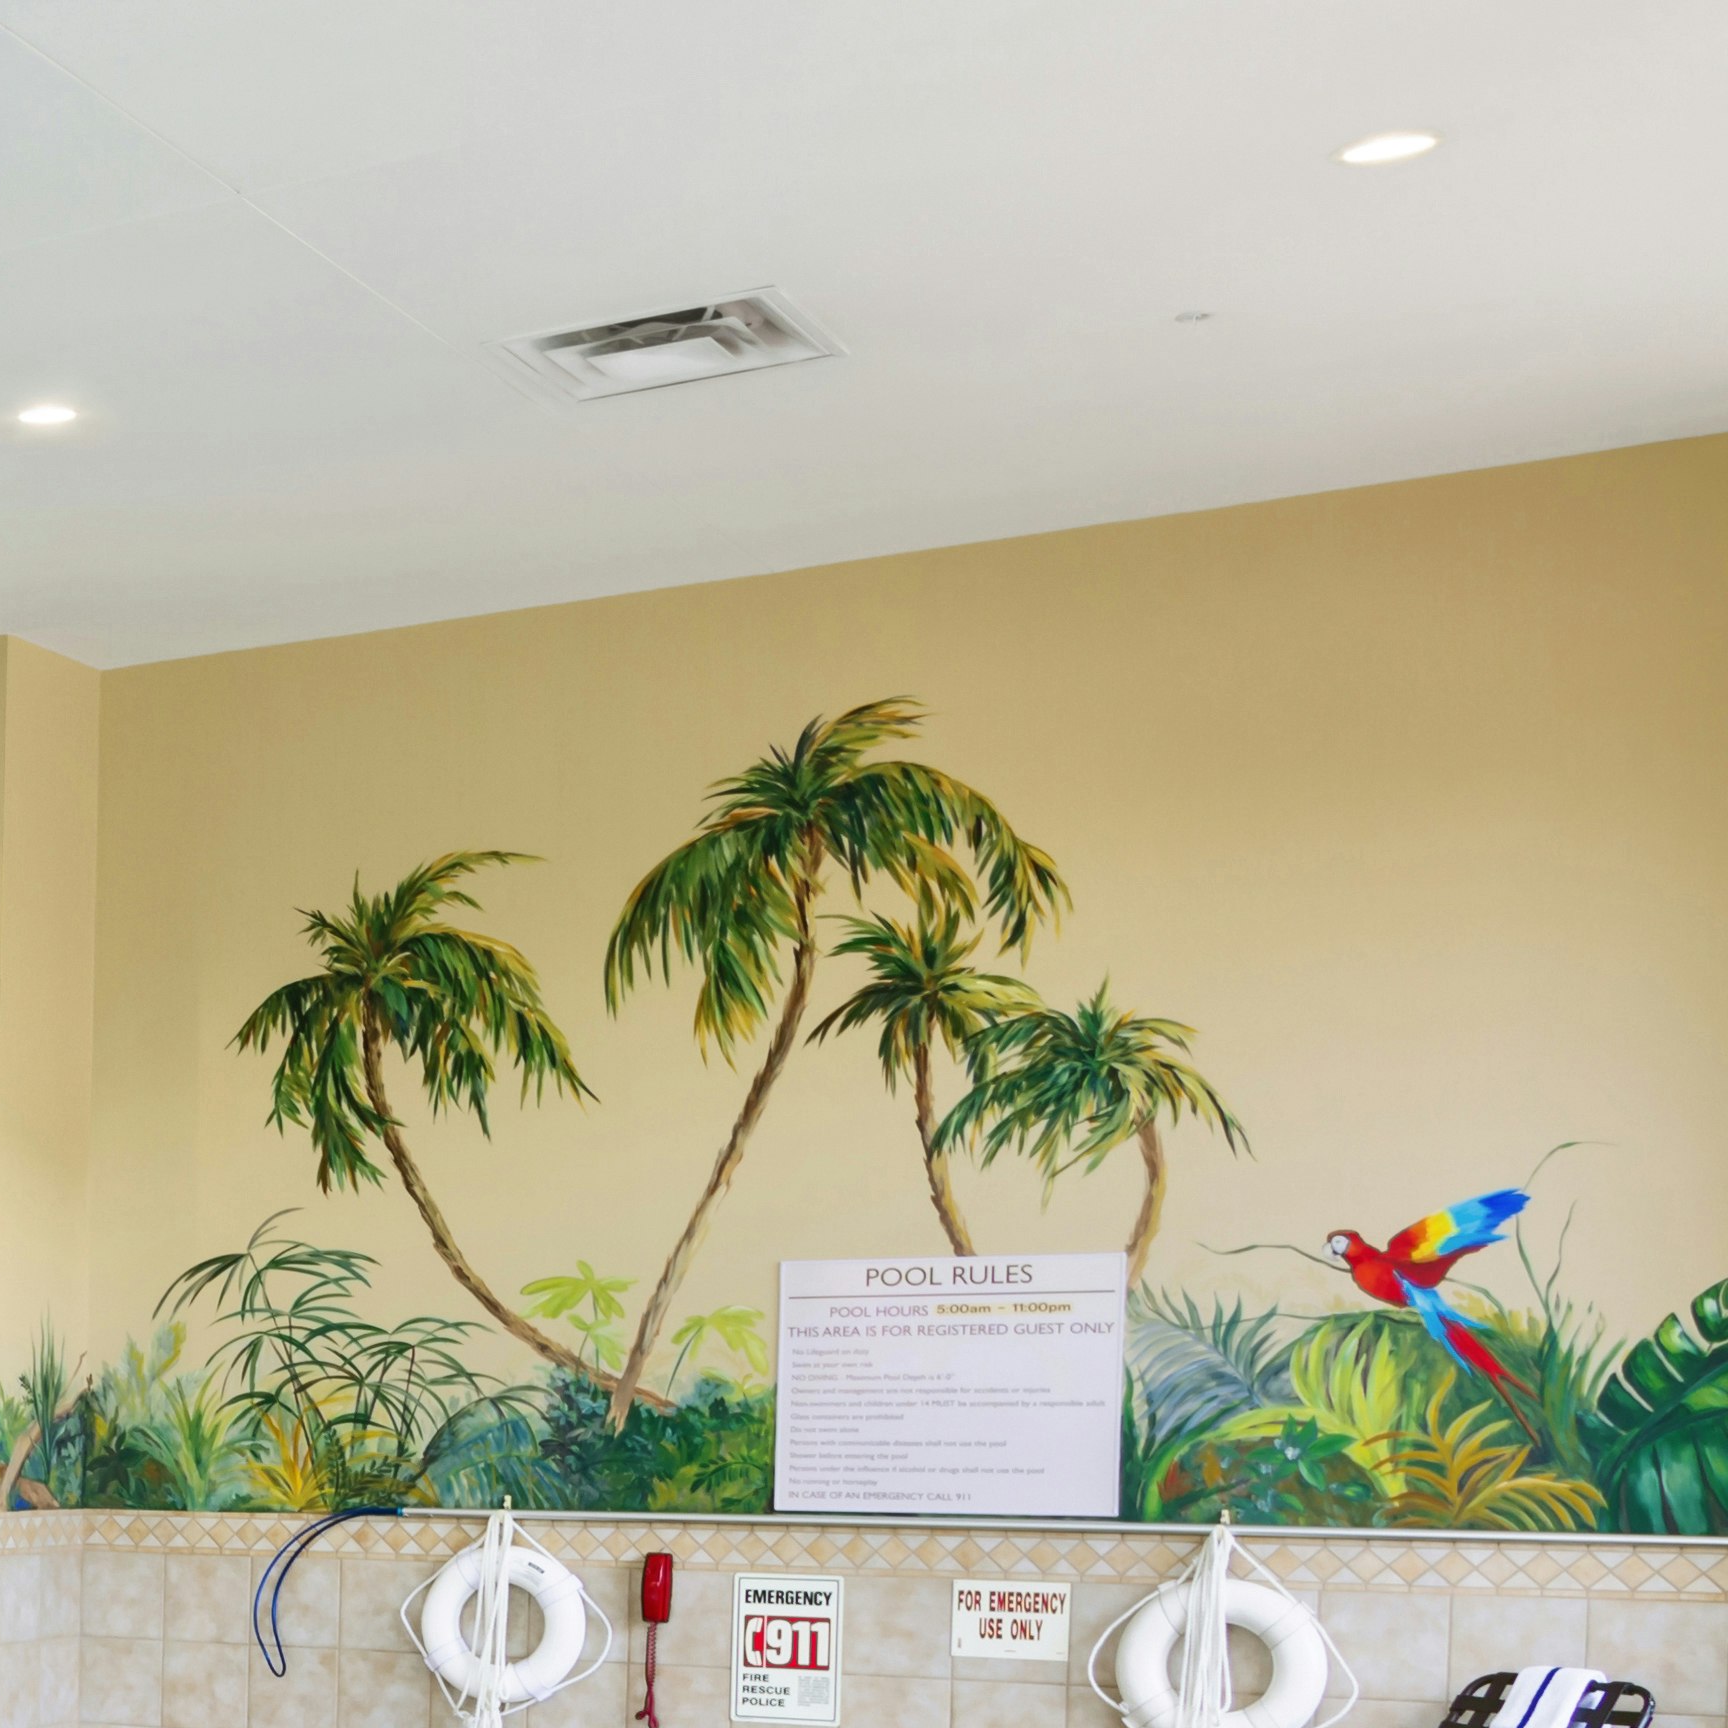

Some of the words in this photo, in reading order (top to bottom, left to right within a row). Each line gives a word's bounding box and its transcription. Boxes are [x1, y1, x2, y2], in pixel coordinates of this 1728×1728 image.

[866, 1267, 942, 1287] POOL
[952, 1264, 1033, 1285] RULES
[829, 1306, 871, 1318] POOL
[876, 1305, 928, 1317] HOURS
[936, 1304, 991, 1314] 5:00am
[1013, 1302, 1071, 1314] 11:00pm
[788, 1327, 819, 1338] THIS
[822, 1326, 861, 1337] AREA
[866, 1326, 877, 1337] IS
[882, 1325, 912, 1336] FOR
[917, 1324, 1008, 1336] REGISTERED
[1014, 1323, 1064, 1335] GUEST
[1070, 1322, 1115, 1334] ONLY
[788, 1491, 800, 1500] IN
[801, 1491, 827, 1500] CASE
[829, 1491, 843, 1500] OF
[844, 1491, 859, 1500] AN
[863, 1492, 924, 1501] EMERGENCY
[927, 1492, 952, 1501] CALL
[955, 1492, 972, 1501] 911
[745, 1589, 832, 1606] EMERGENCY
[957, 1590, 981, 1611] FOR
[989, 1591, 1066, 1614] EMERGENCY
[979, 1618, 1003, 1639] USE
[1011, 1619, 1043, 1640] ONLY
[766, 1619, 830, 1667] 911
[743, 1673, 769, 1682] FIRE
[742, 1685, 791, 1695] RESCUE
[742, 1697, 784, 1707] POLICE
